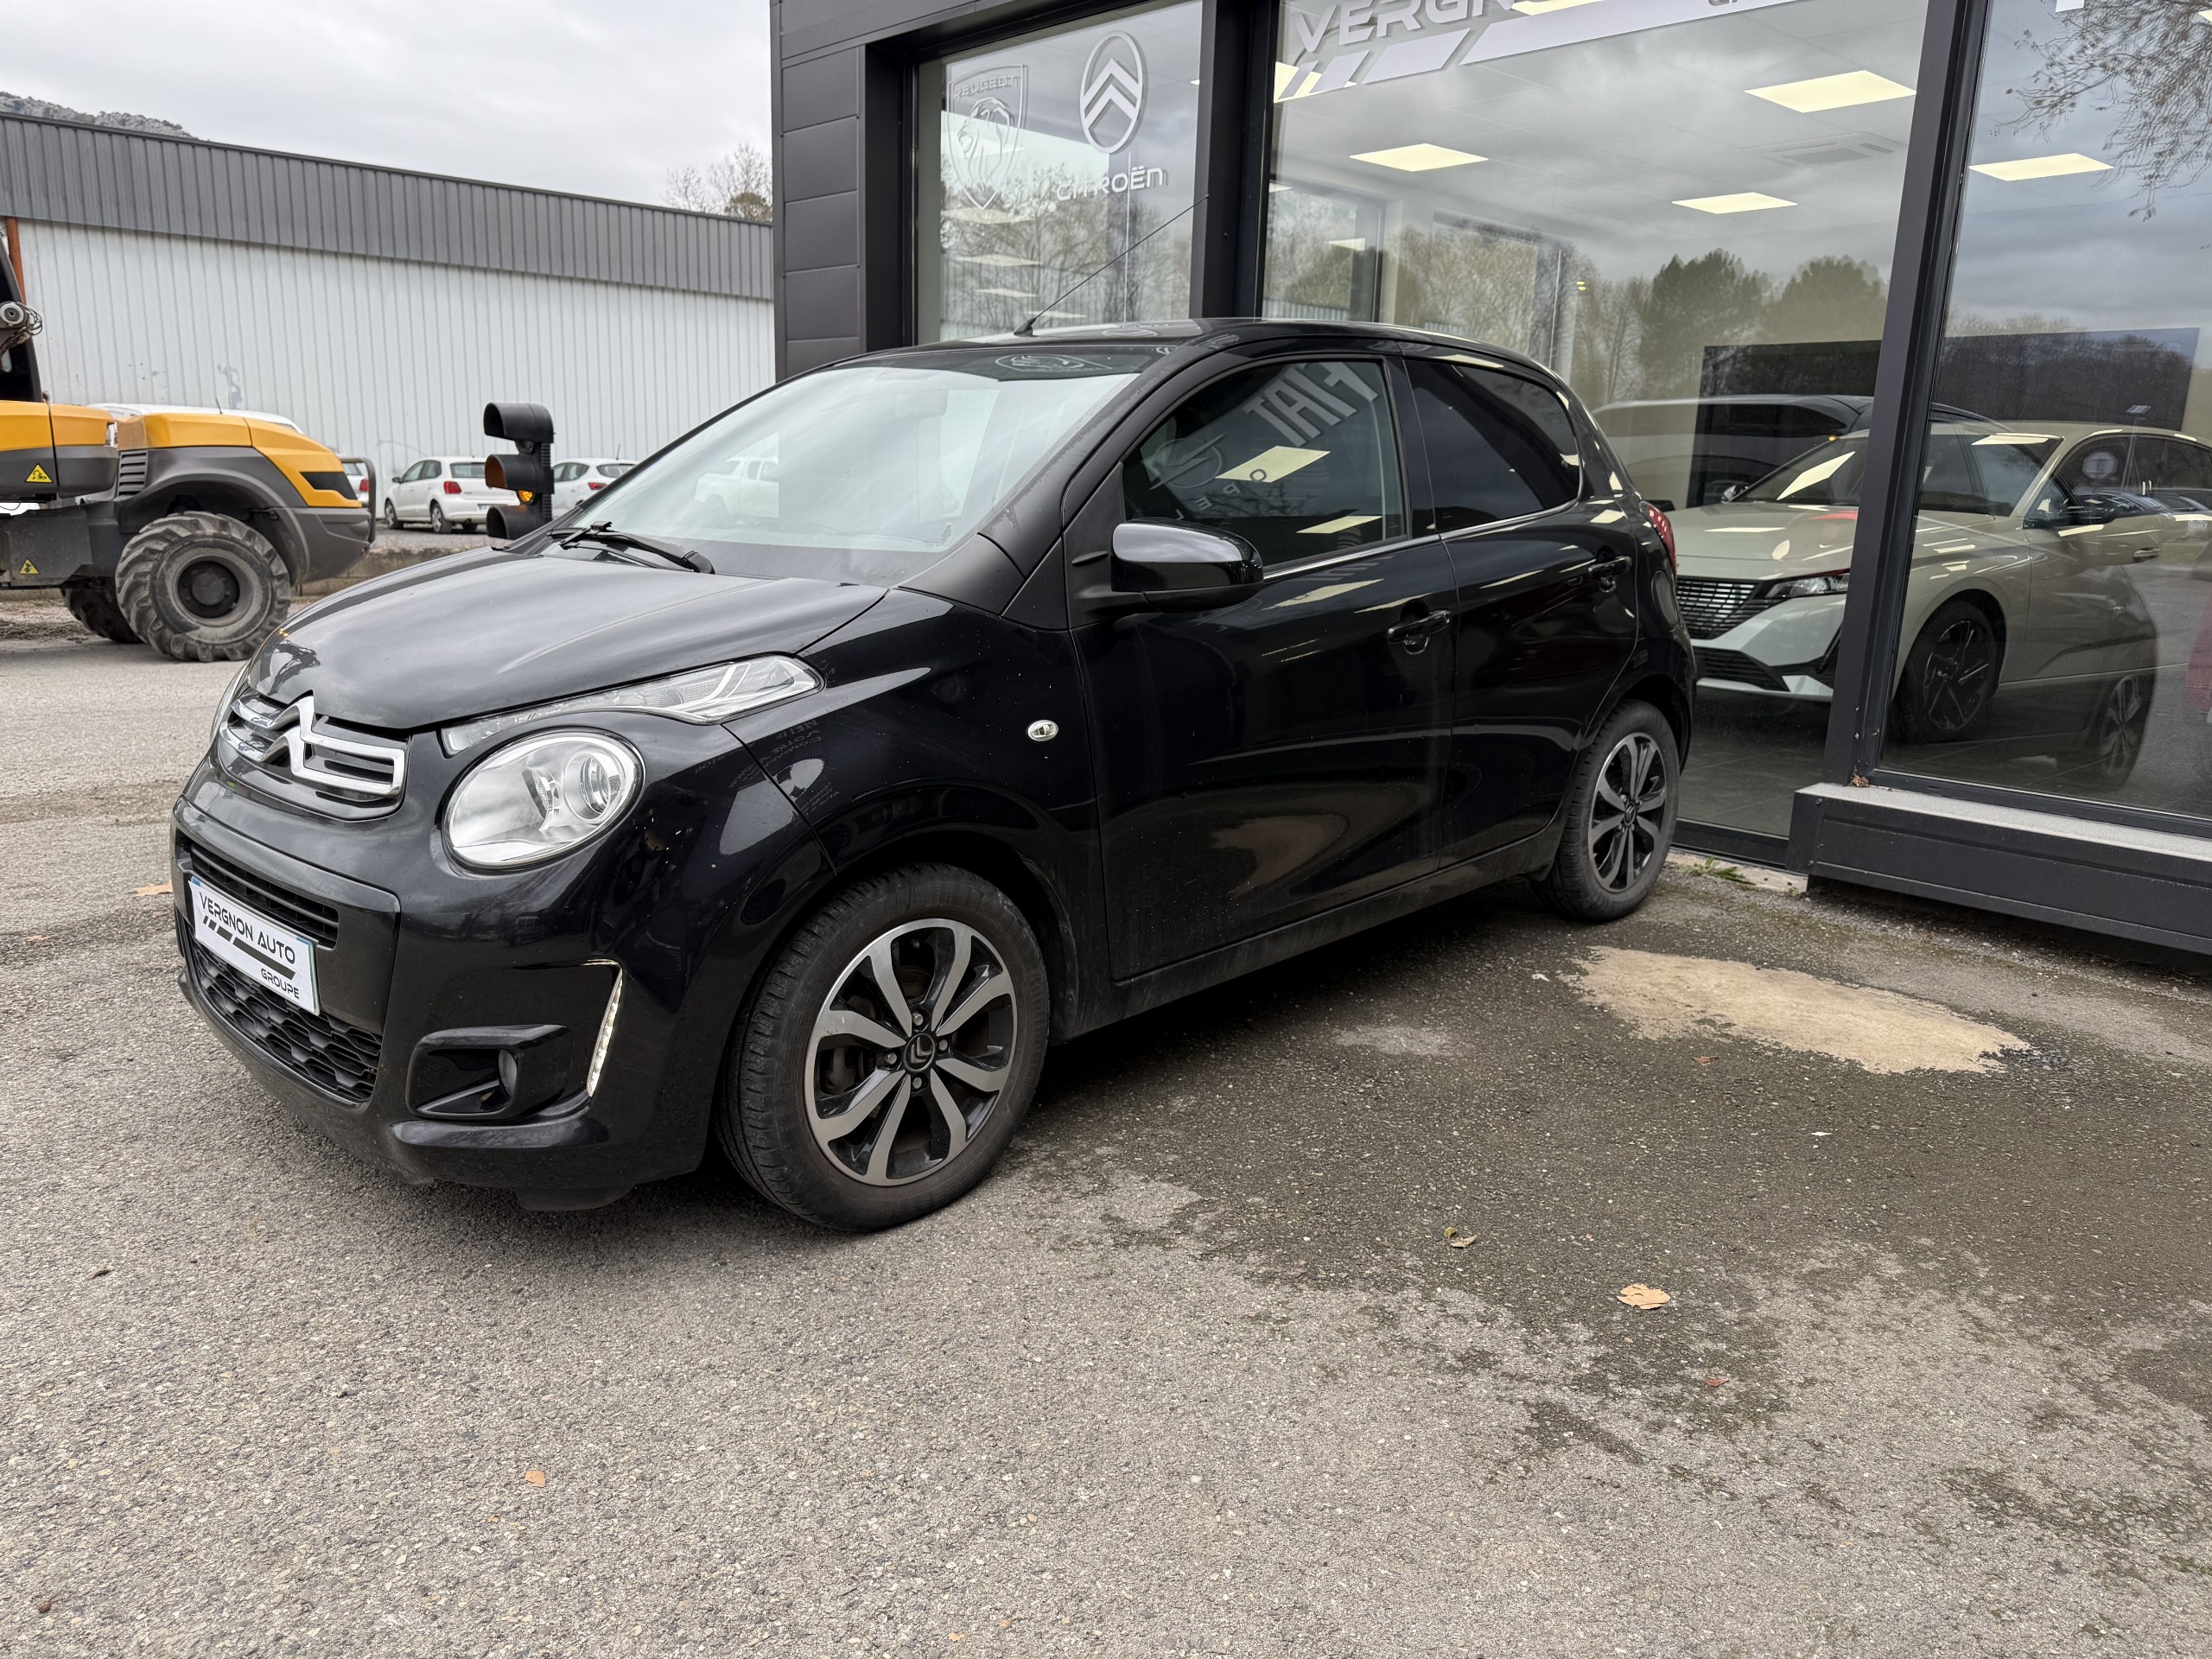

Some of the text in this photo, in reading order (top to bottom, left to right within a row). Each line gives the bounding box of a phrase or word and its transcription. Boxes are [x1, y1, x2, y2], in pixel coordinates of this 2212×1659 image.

[952, 74, 1018, 98] PEUGEOT
[199, 891, 296, 965] VERGNON AUTO
[260, 967, 301, 1001] GROUPE
